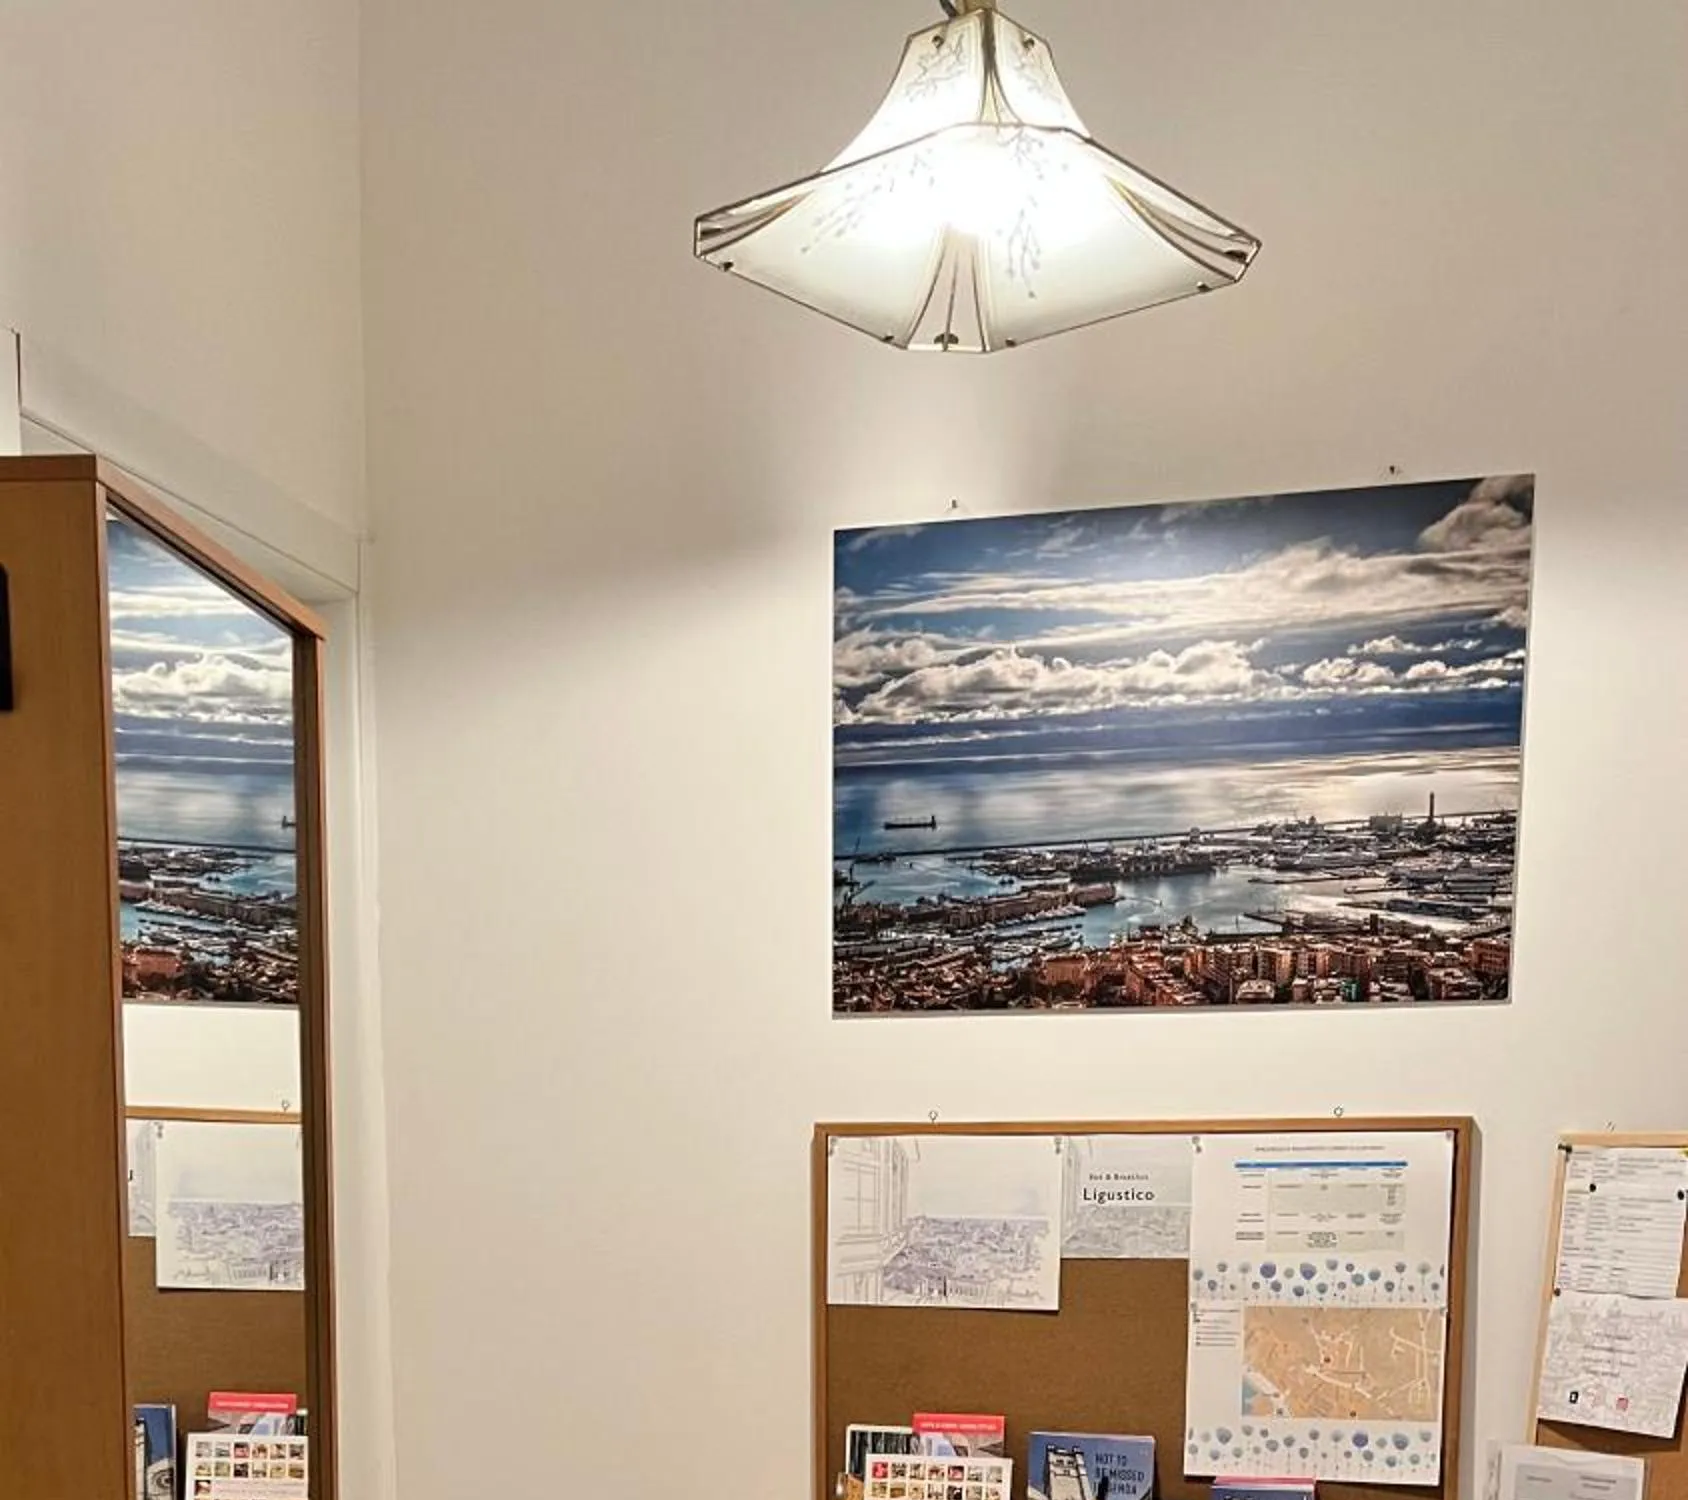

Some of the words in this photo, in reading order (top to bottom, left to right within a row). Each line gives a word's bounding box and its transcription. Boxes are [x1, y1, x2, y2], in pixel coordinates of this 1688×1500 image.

[1083, 1187, 1155, 1205] Ligustico
[1095, 1453, 1113, 1465] NOT
[1109, 1469, 1145, 1482] MISSED
